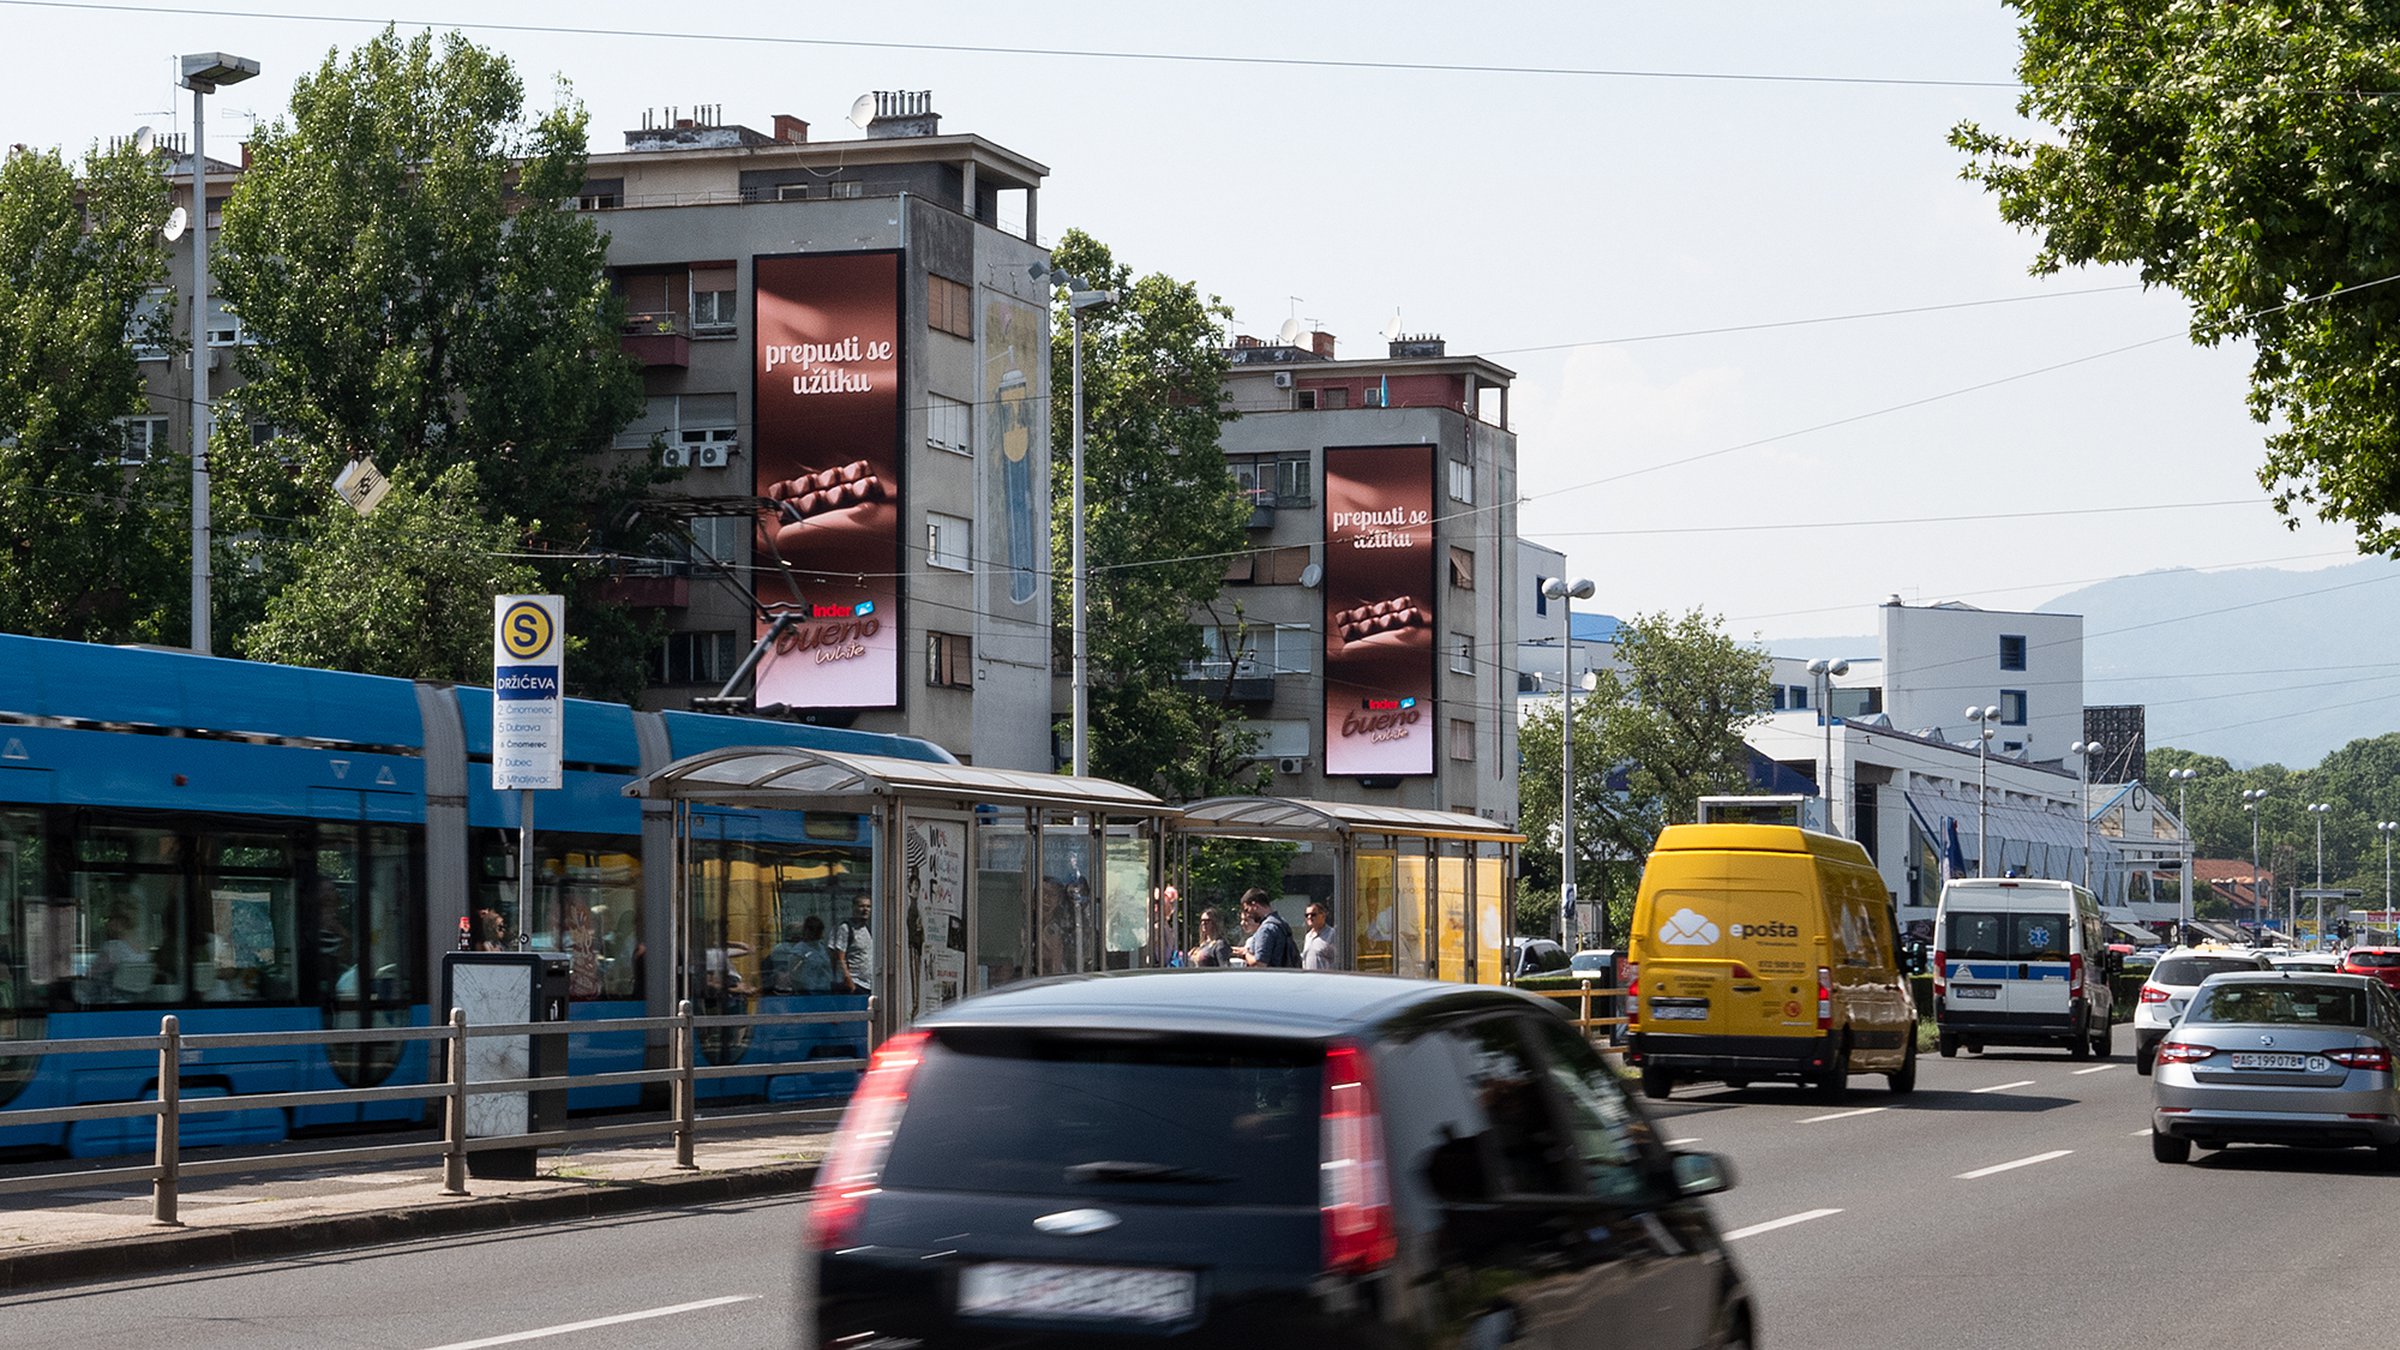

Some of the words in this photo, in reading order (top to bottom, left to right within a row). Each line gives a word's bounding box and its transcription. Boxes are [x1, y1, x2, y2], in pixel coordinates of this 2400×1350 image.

[766, 336, 862, 372] prepusti
[866, 341, 893, 360] se
[793, 367, 872, 394] užitku
[1333, 506, 1406, 532] prepusti
[1409, 510, 1428, 524] se
[513, 614, 538, 647] S
[497, 674, 556, 690] DRŽIĆEVA
[498, 705, 504, 715] 2
[506, 704, 553, 714] Črnomerec
[498, 722, 505, 733] 5
[506, 723, 541, 732] Dubrava
[1341, 708, 1420, 738] bueno
[506, 739, 547, 748] Črnomerec
[498, 757, 504, 767] 7
[505, 758, 532, 767] Dubec
[1729, 920, 1798, 939] epošta
[2310, 1058, 2325, 1069] CH
